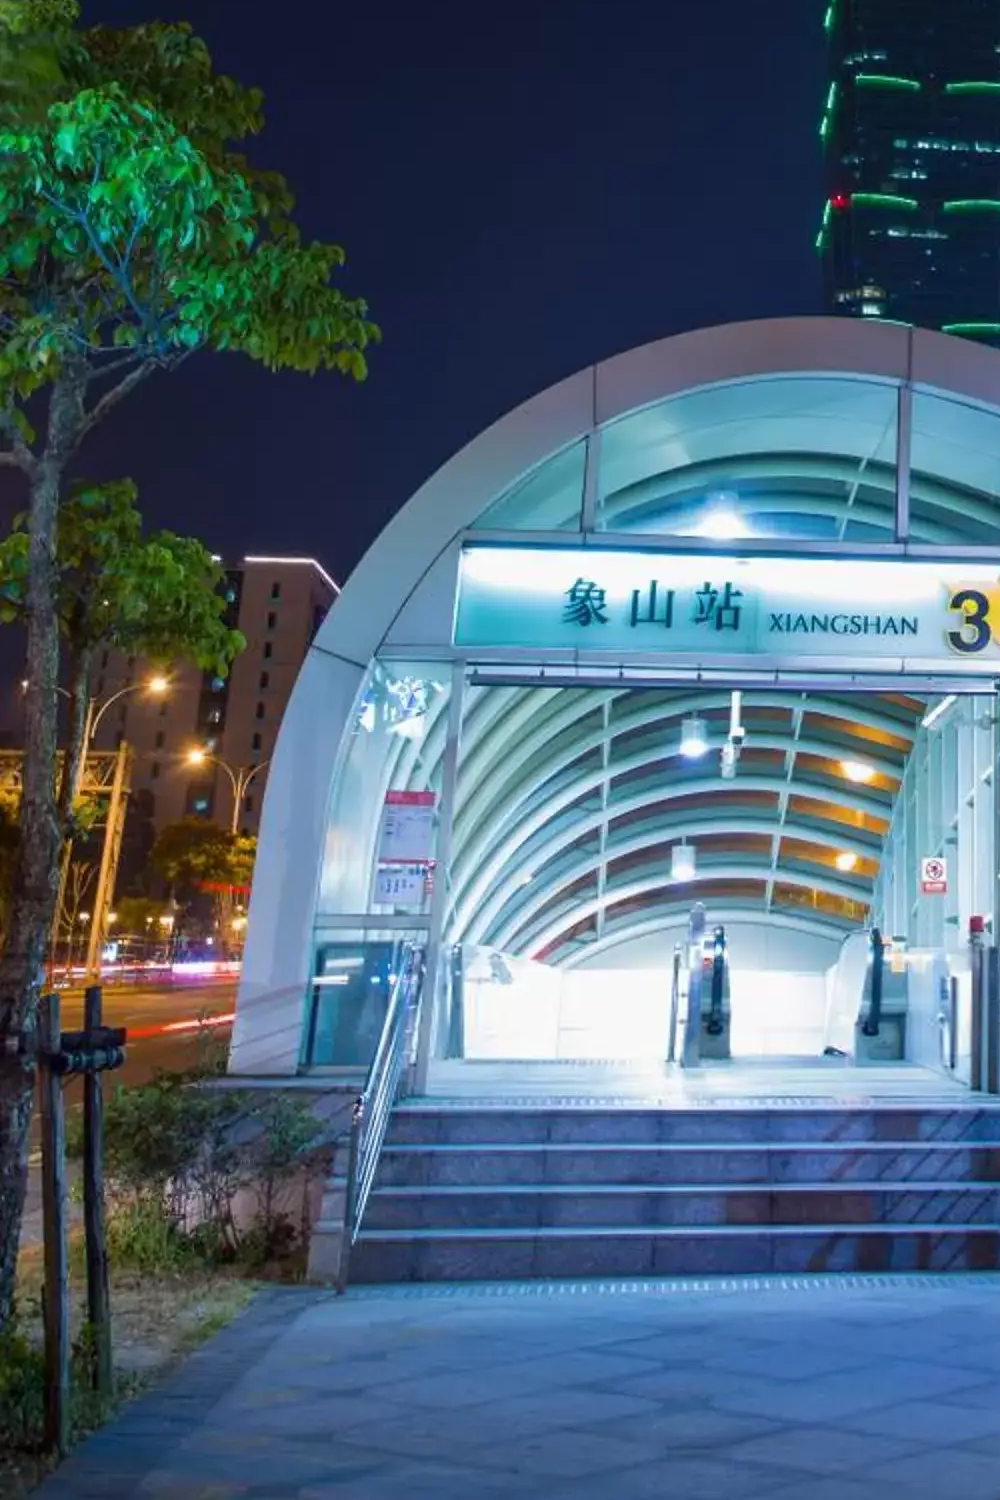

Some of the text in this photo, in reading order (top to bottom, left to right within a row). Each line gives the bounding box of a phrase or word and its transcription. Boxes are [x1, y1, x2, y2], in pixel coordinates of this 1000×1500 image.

[562, 577, 744, 632] 象山站
[769, 612, 919, 636] XIANGSHAN
[948, 589, 991, 653] 3
